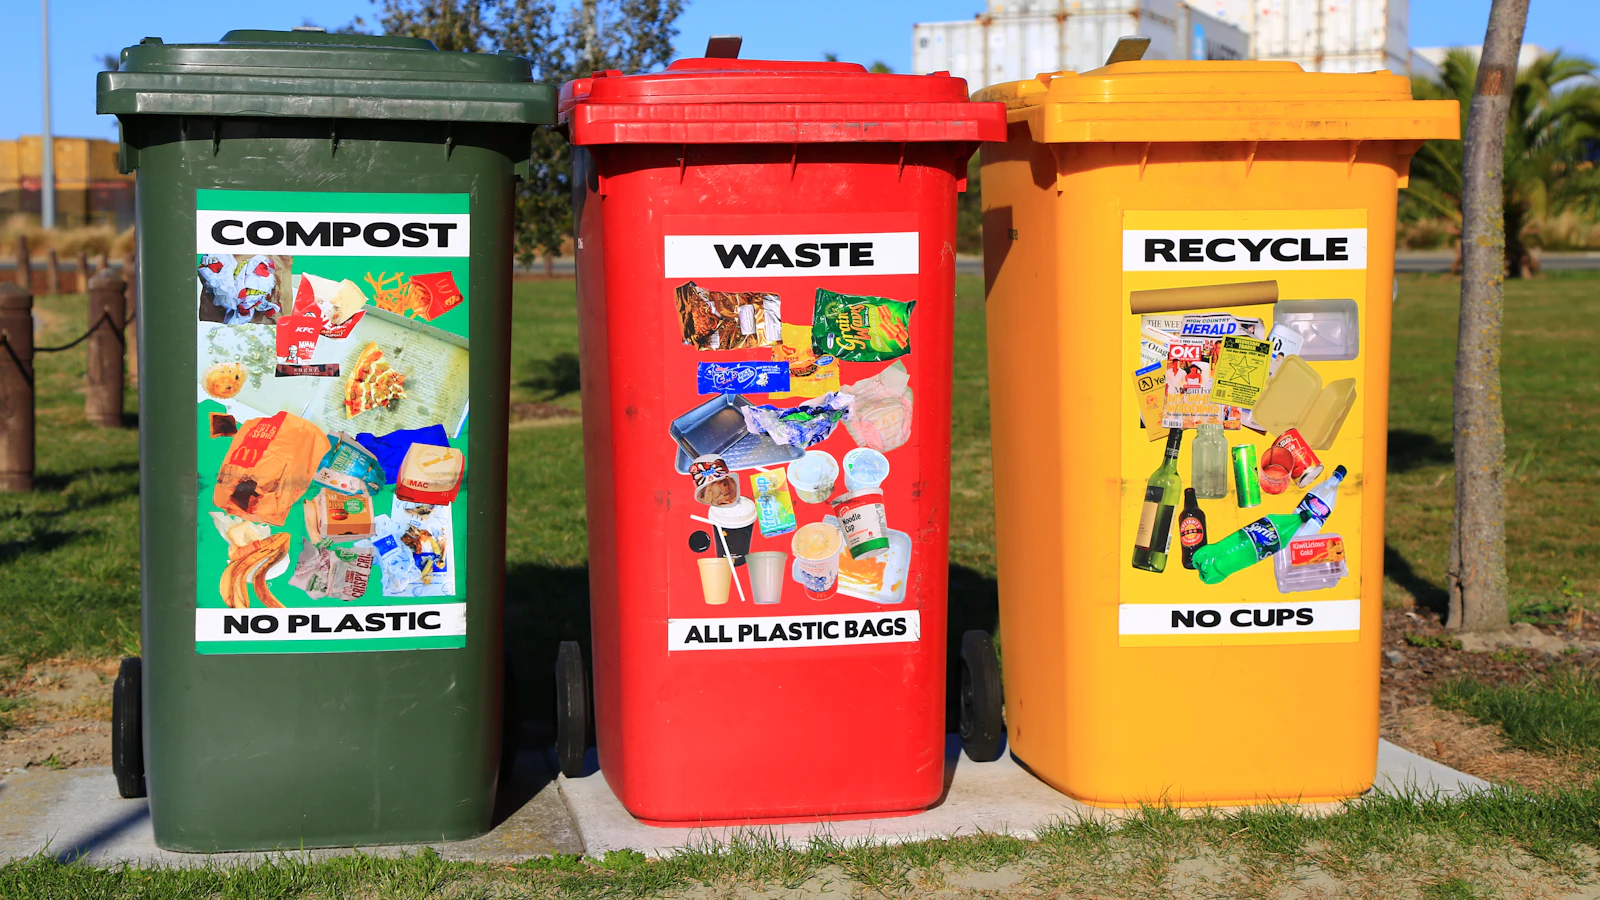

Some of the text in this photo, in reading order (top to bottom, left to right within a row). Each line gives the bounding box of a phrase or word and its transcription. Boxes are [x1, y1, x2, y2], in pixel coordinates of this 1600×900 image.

[211, 219, 458, 248] COMPOST
[713, 242, 875, 269] WASTE
[1144, 237, 1349, 263] RECYCLE
[295, 326, 315, 334] KFC
[1147, 319, 1182, 328] THE WEE
[1182, 322, 1237, 336] HERALD
[1170, 345, 1200, 359] OK!
[1167, 403, 1219, 414] WEDDING
[841, 512, 861, 526] Noodle
[844, 524, 855, 533] Cup
[1245, 522, 1278, 541] Sprite
[1299, 548, 1313, 556] Gold
[223, 611, 441, 634] NO PLASTIC
[1171, 608, 1314, 628] NO CUPS
[684, 617, 908, 644] ALL PLASTIC BAGS
